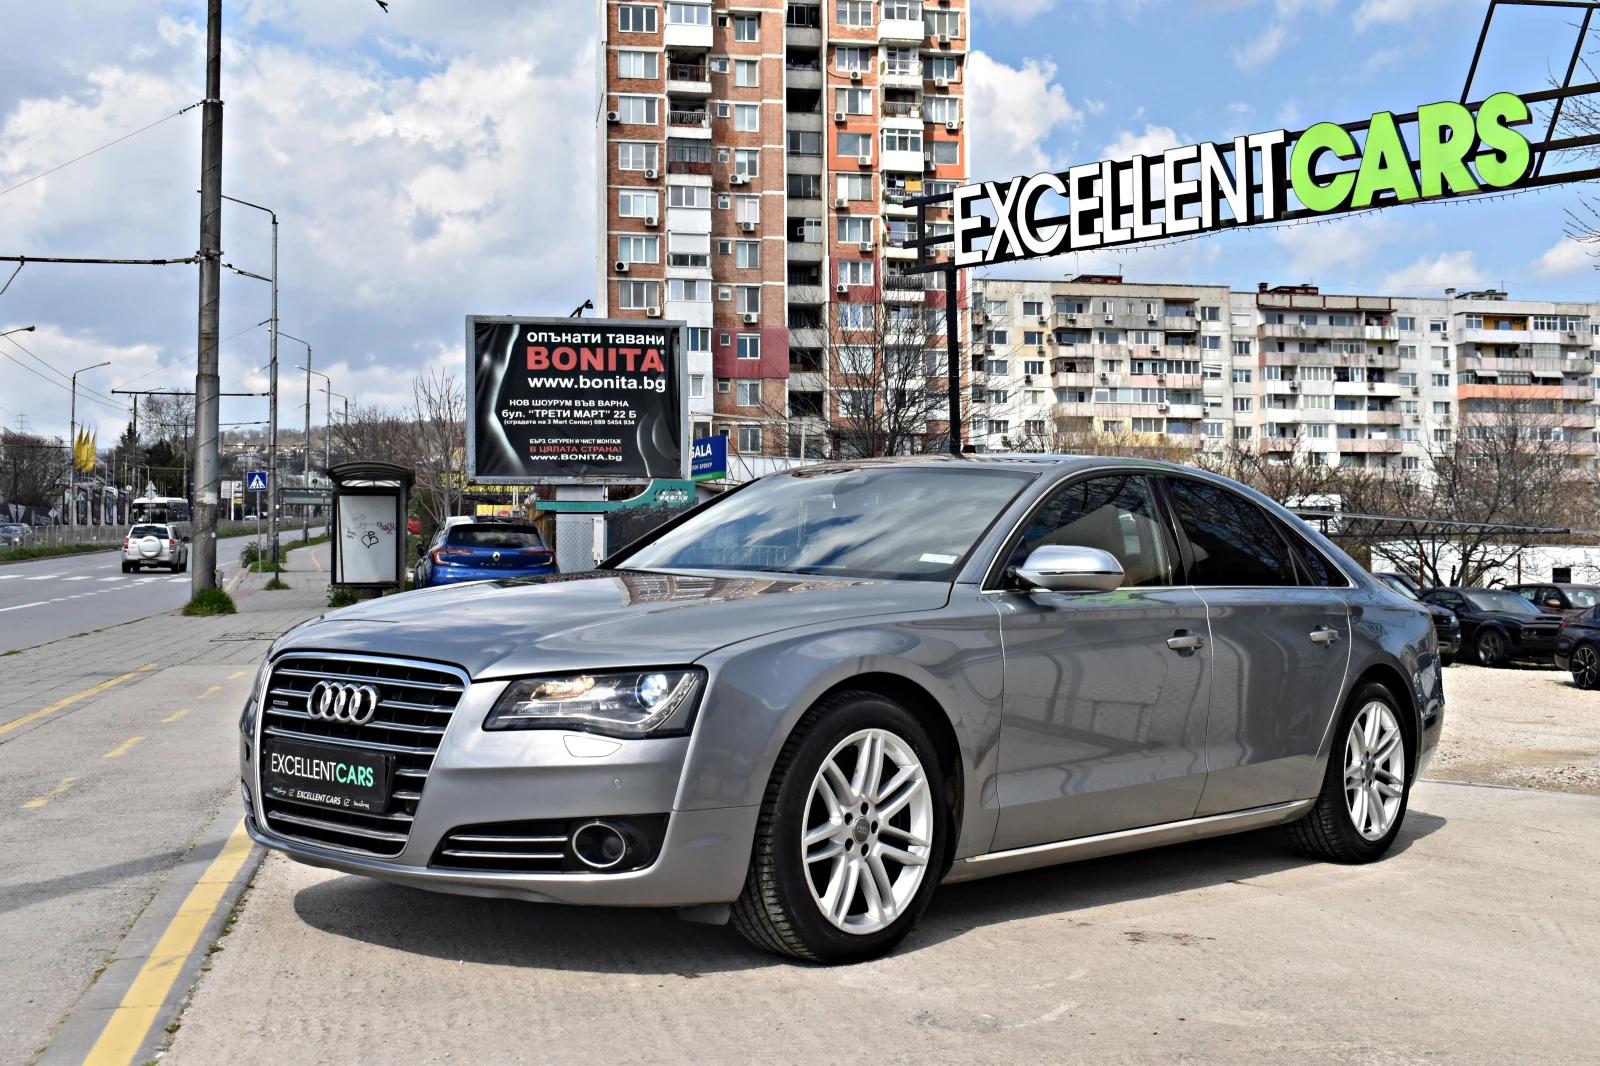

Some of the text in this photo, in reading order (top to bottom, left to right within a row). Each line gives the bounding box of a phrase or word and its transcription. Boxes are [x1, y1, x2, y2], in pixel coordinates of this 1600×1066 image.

[527, 331, 665, 345] опънати тавани
[527, 346, 665, 372] BONITA
[528, 375, 666, 393] www.bonita.bg
[532, 399, 573, 407] ШОУРУМ
[501, 409, 526, 419] бул.
[613, 410, 626, 418] 22
[629, 410, 637, 418] Б
[539, 446, 578, 454] ЦЯЛАТА
[297, 790, 327, 803] EXCELLENT
[326, 795, 342, 805] CARS
